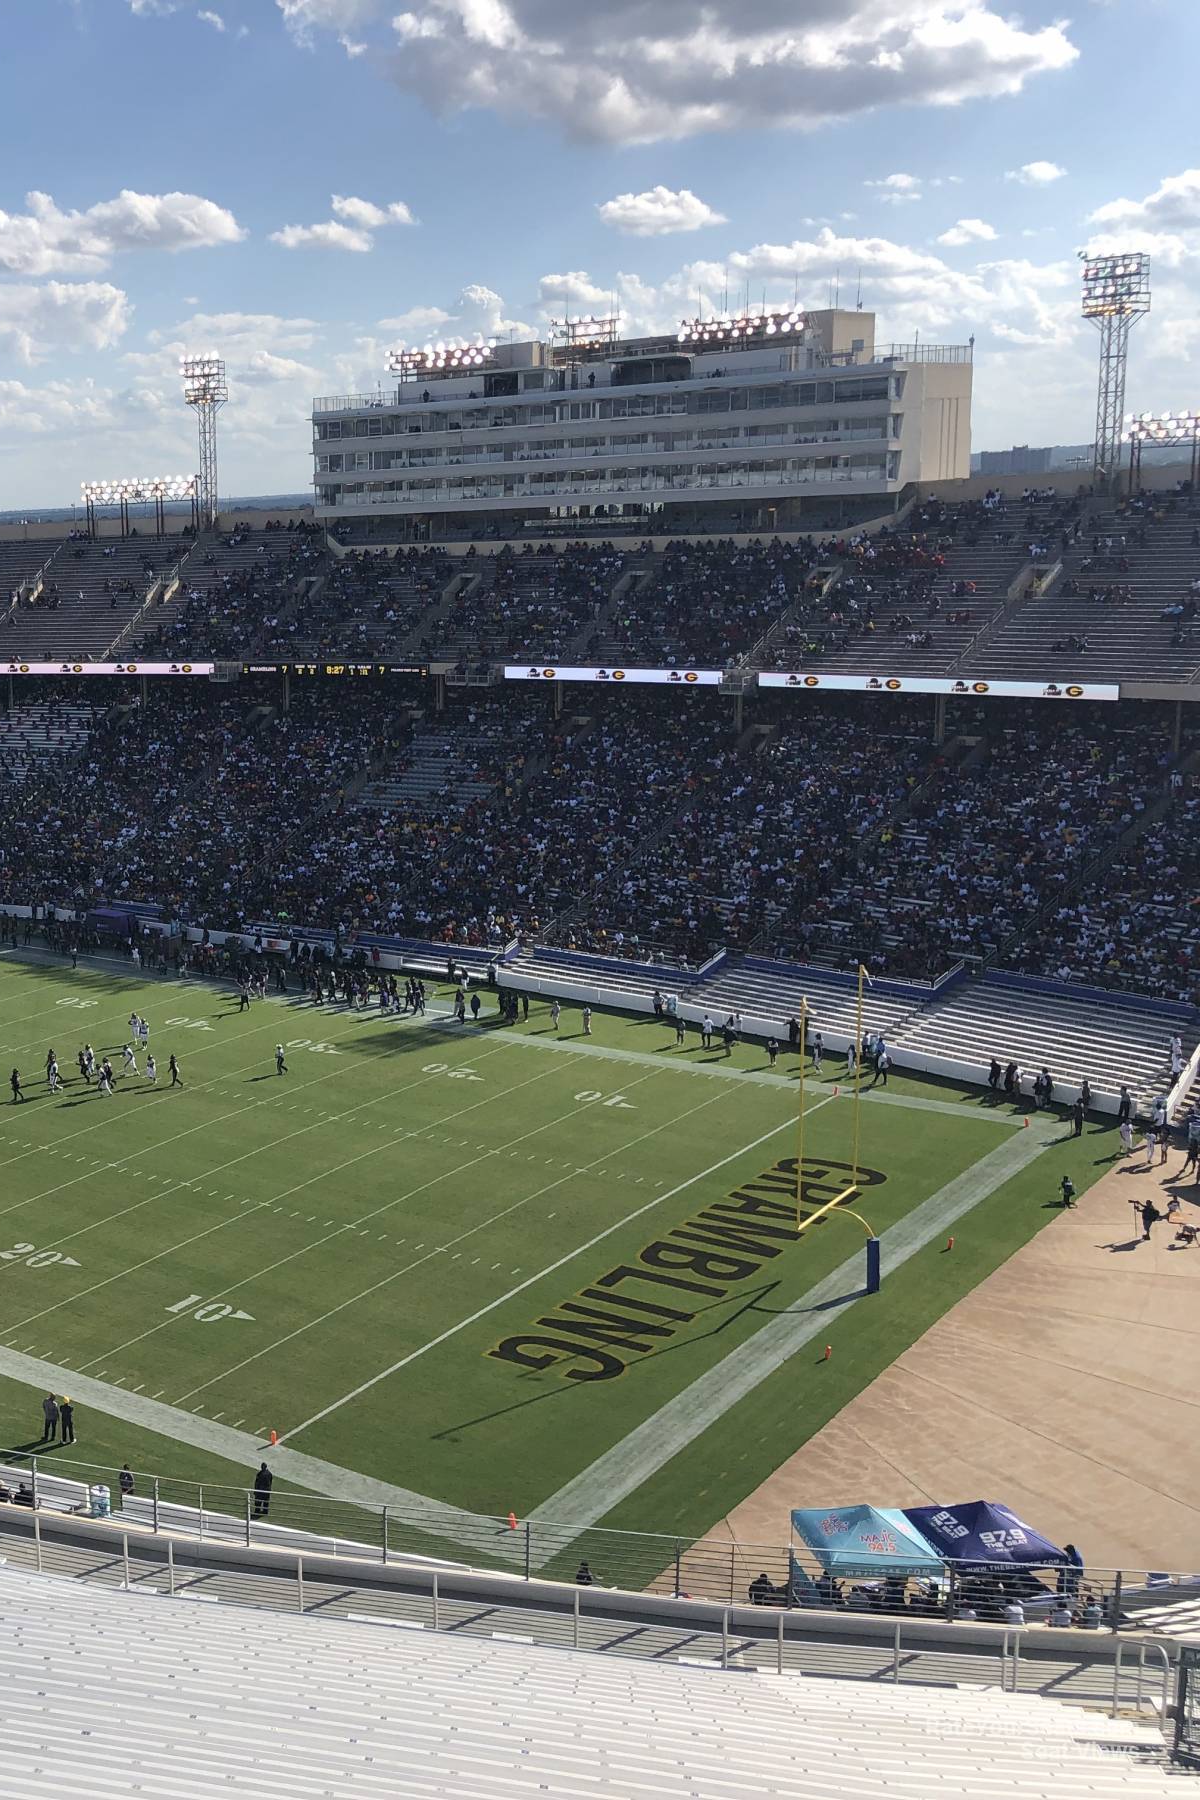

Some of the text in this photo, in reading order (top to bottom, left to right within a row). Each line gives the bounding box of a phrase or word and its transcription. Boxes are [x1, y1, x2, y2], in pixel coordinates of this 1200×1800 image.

[281, 665, 287, 673] 7
[326, 665, 345, 675] 8:27
[421, 1063, 478, 1079] 20
[573, 1090, 628, 1107] 10
[484, 1156, 888, 1382] GRAMBLING
[164, 1293, 233, 1322] 10
[935, 1510, 970, 1537] 97.9
[978, 1528, 1026, 1544] 97.9
[868, 1542, 897, 1552] 94.5
